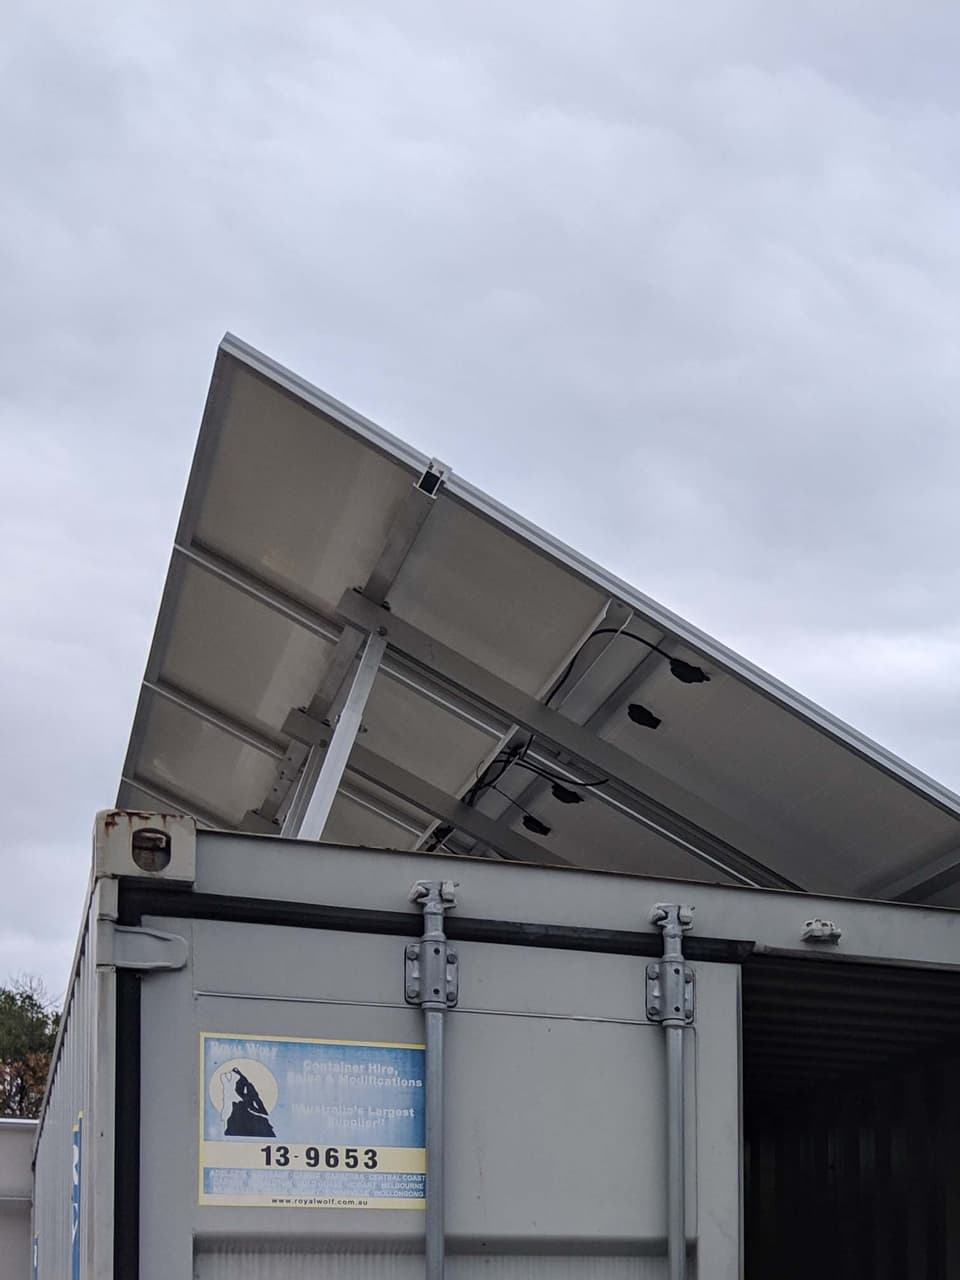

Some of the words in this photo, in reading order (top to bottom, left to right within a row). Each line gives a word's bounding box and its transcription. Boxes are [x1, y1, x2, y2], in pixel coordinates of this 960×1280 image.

[303, 1059, 365, 1074] Container
[340, 1073, 423, 1088] Modifications
[368, 1105, 415, 1119] Largest
[271, 1197, 368, 1207] www.royalwolf.com.au
